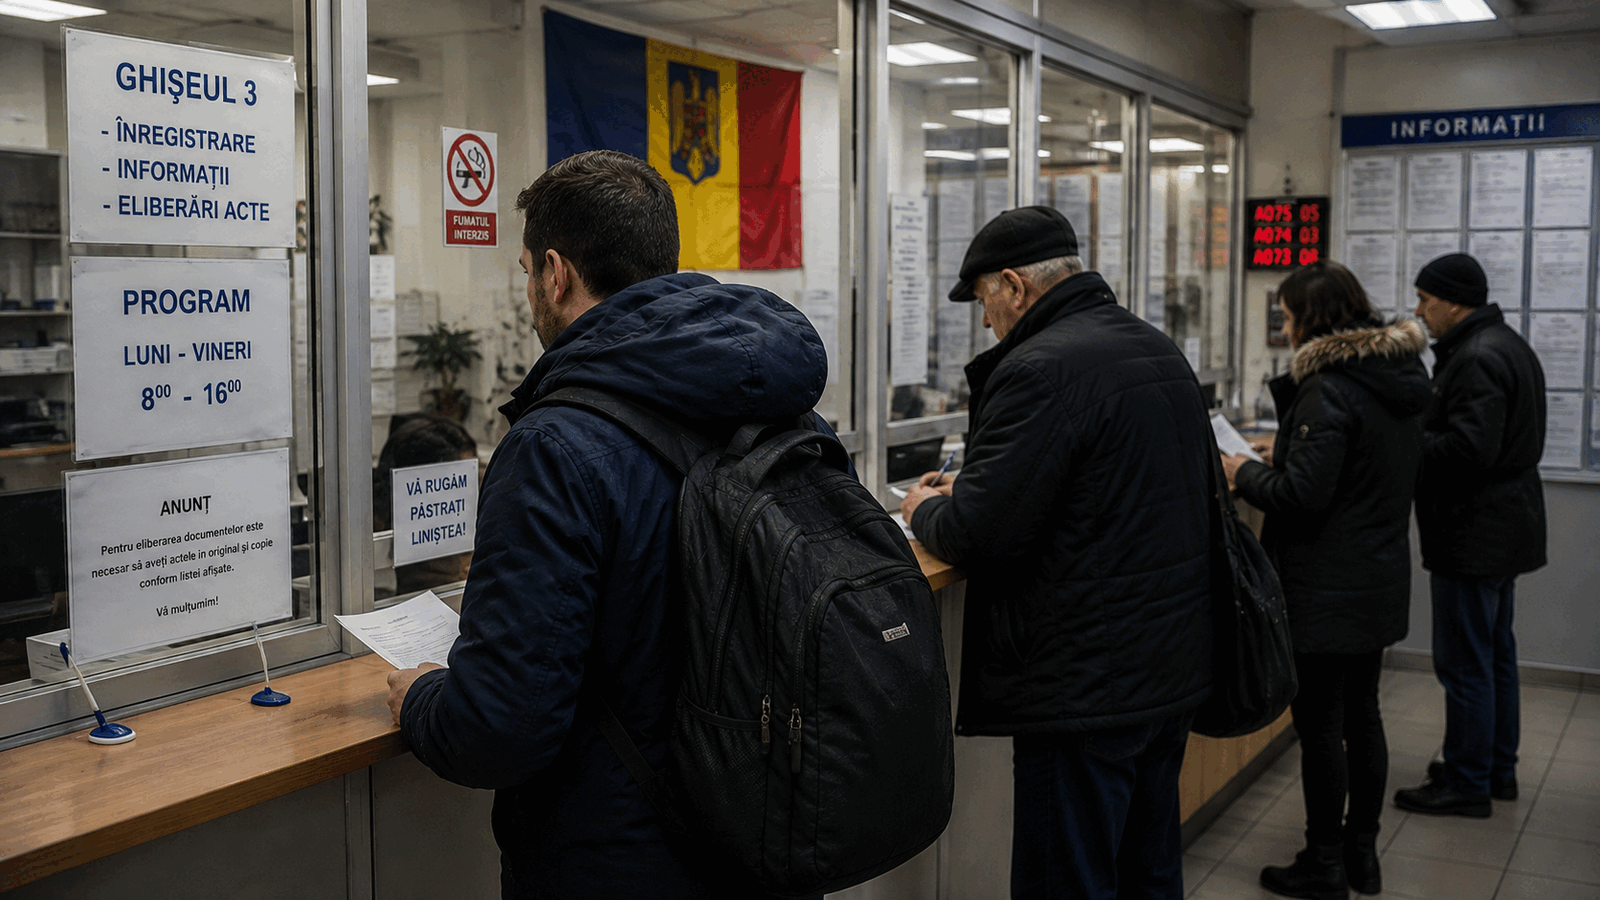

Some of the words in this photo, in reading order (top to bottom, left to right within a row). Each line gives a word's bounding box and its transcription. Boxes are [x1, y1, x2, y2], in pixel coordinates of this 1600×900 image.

[244, 80, 257, 106] 3
[116, 116, 256, 153] ÎNREGISTRARE
[118, 195, 218, 219] ELIBERĂRI
[224, 201, 270, 221] ACTE
[1254, 204, 1292, 222] A075
[1300, 204, 1320, 223] 05
[453, 215, 490, 227] FUMATUL
[454, 230, 489, 241] INTERZIS
[1254, 226, 1292, 244] A074
[1253, 248, 1291, 266] A073
[123, 289, 250, 315] PROGRAM
[124, 344, 170, 366] LUNI
[192, 341, 251, 362] VINERI
[101, 541, 134, 556] Pentru
[136, 533, 182, 551] eliberarea
[184, 524, 244, 542] documentelor
[246, 521, 264, 532] este
[91, 563, 130, 579] necesar
[169, 551, 196, 565] actele
[208, 543, 240, 559] original
[250, 538, 274, 552] copie
[139, 572, 178, 589] conform
[180, 570, 201, 581] listei
